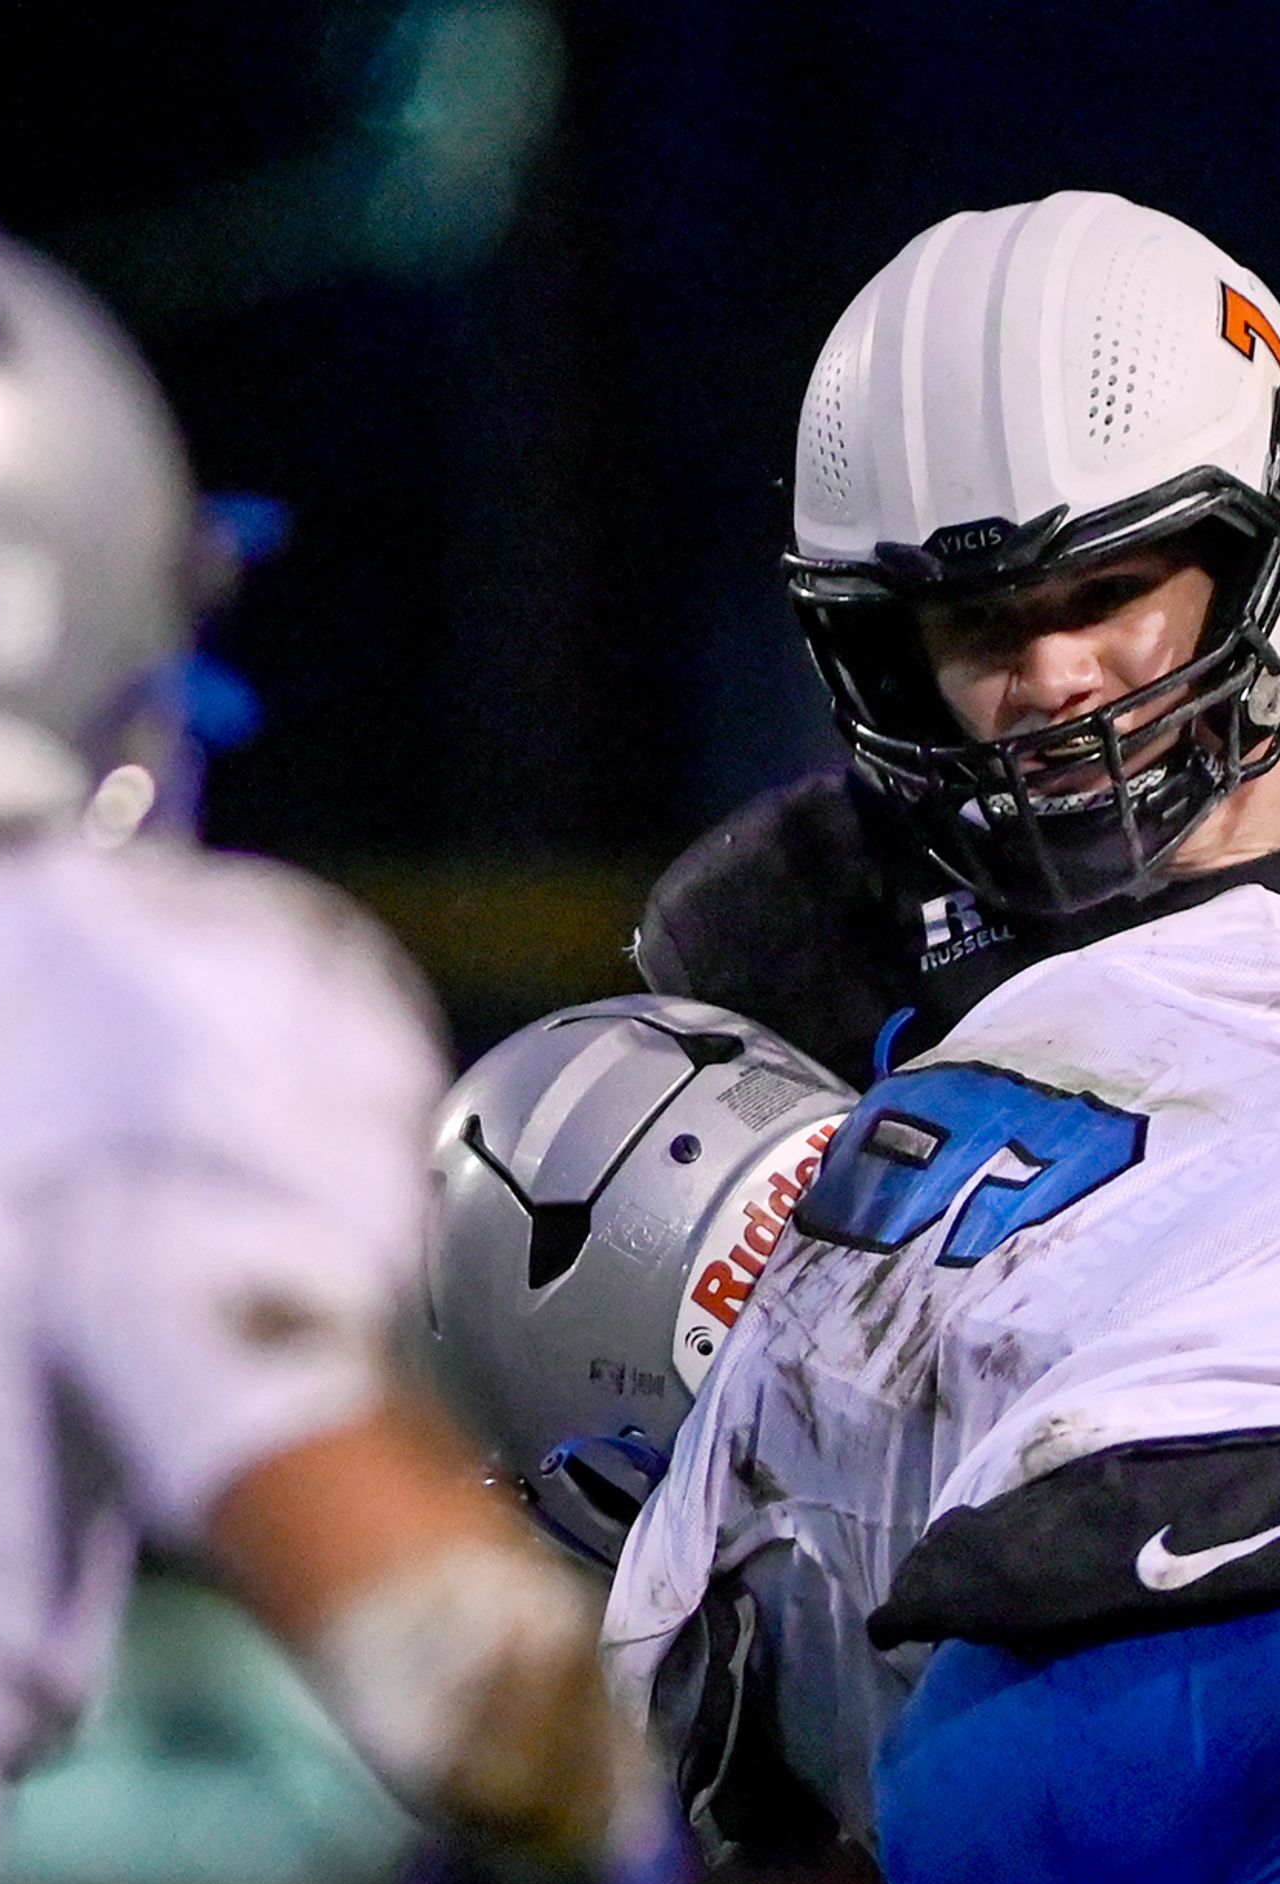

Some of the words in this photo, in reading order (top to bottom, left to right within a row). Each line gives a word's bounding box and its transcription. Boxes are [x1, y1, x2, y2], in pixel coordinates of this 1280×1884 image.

[938, 526, 1004, 554] VICIS
[920, 925, 1016, 973] RUSSELL
[790, 1060, 1150, 1268] 9
